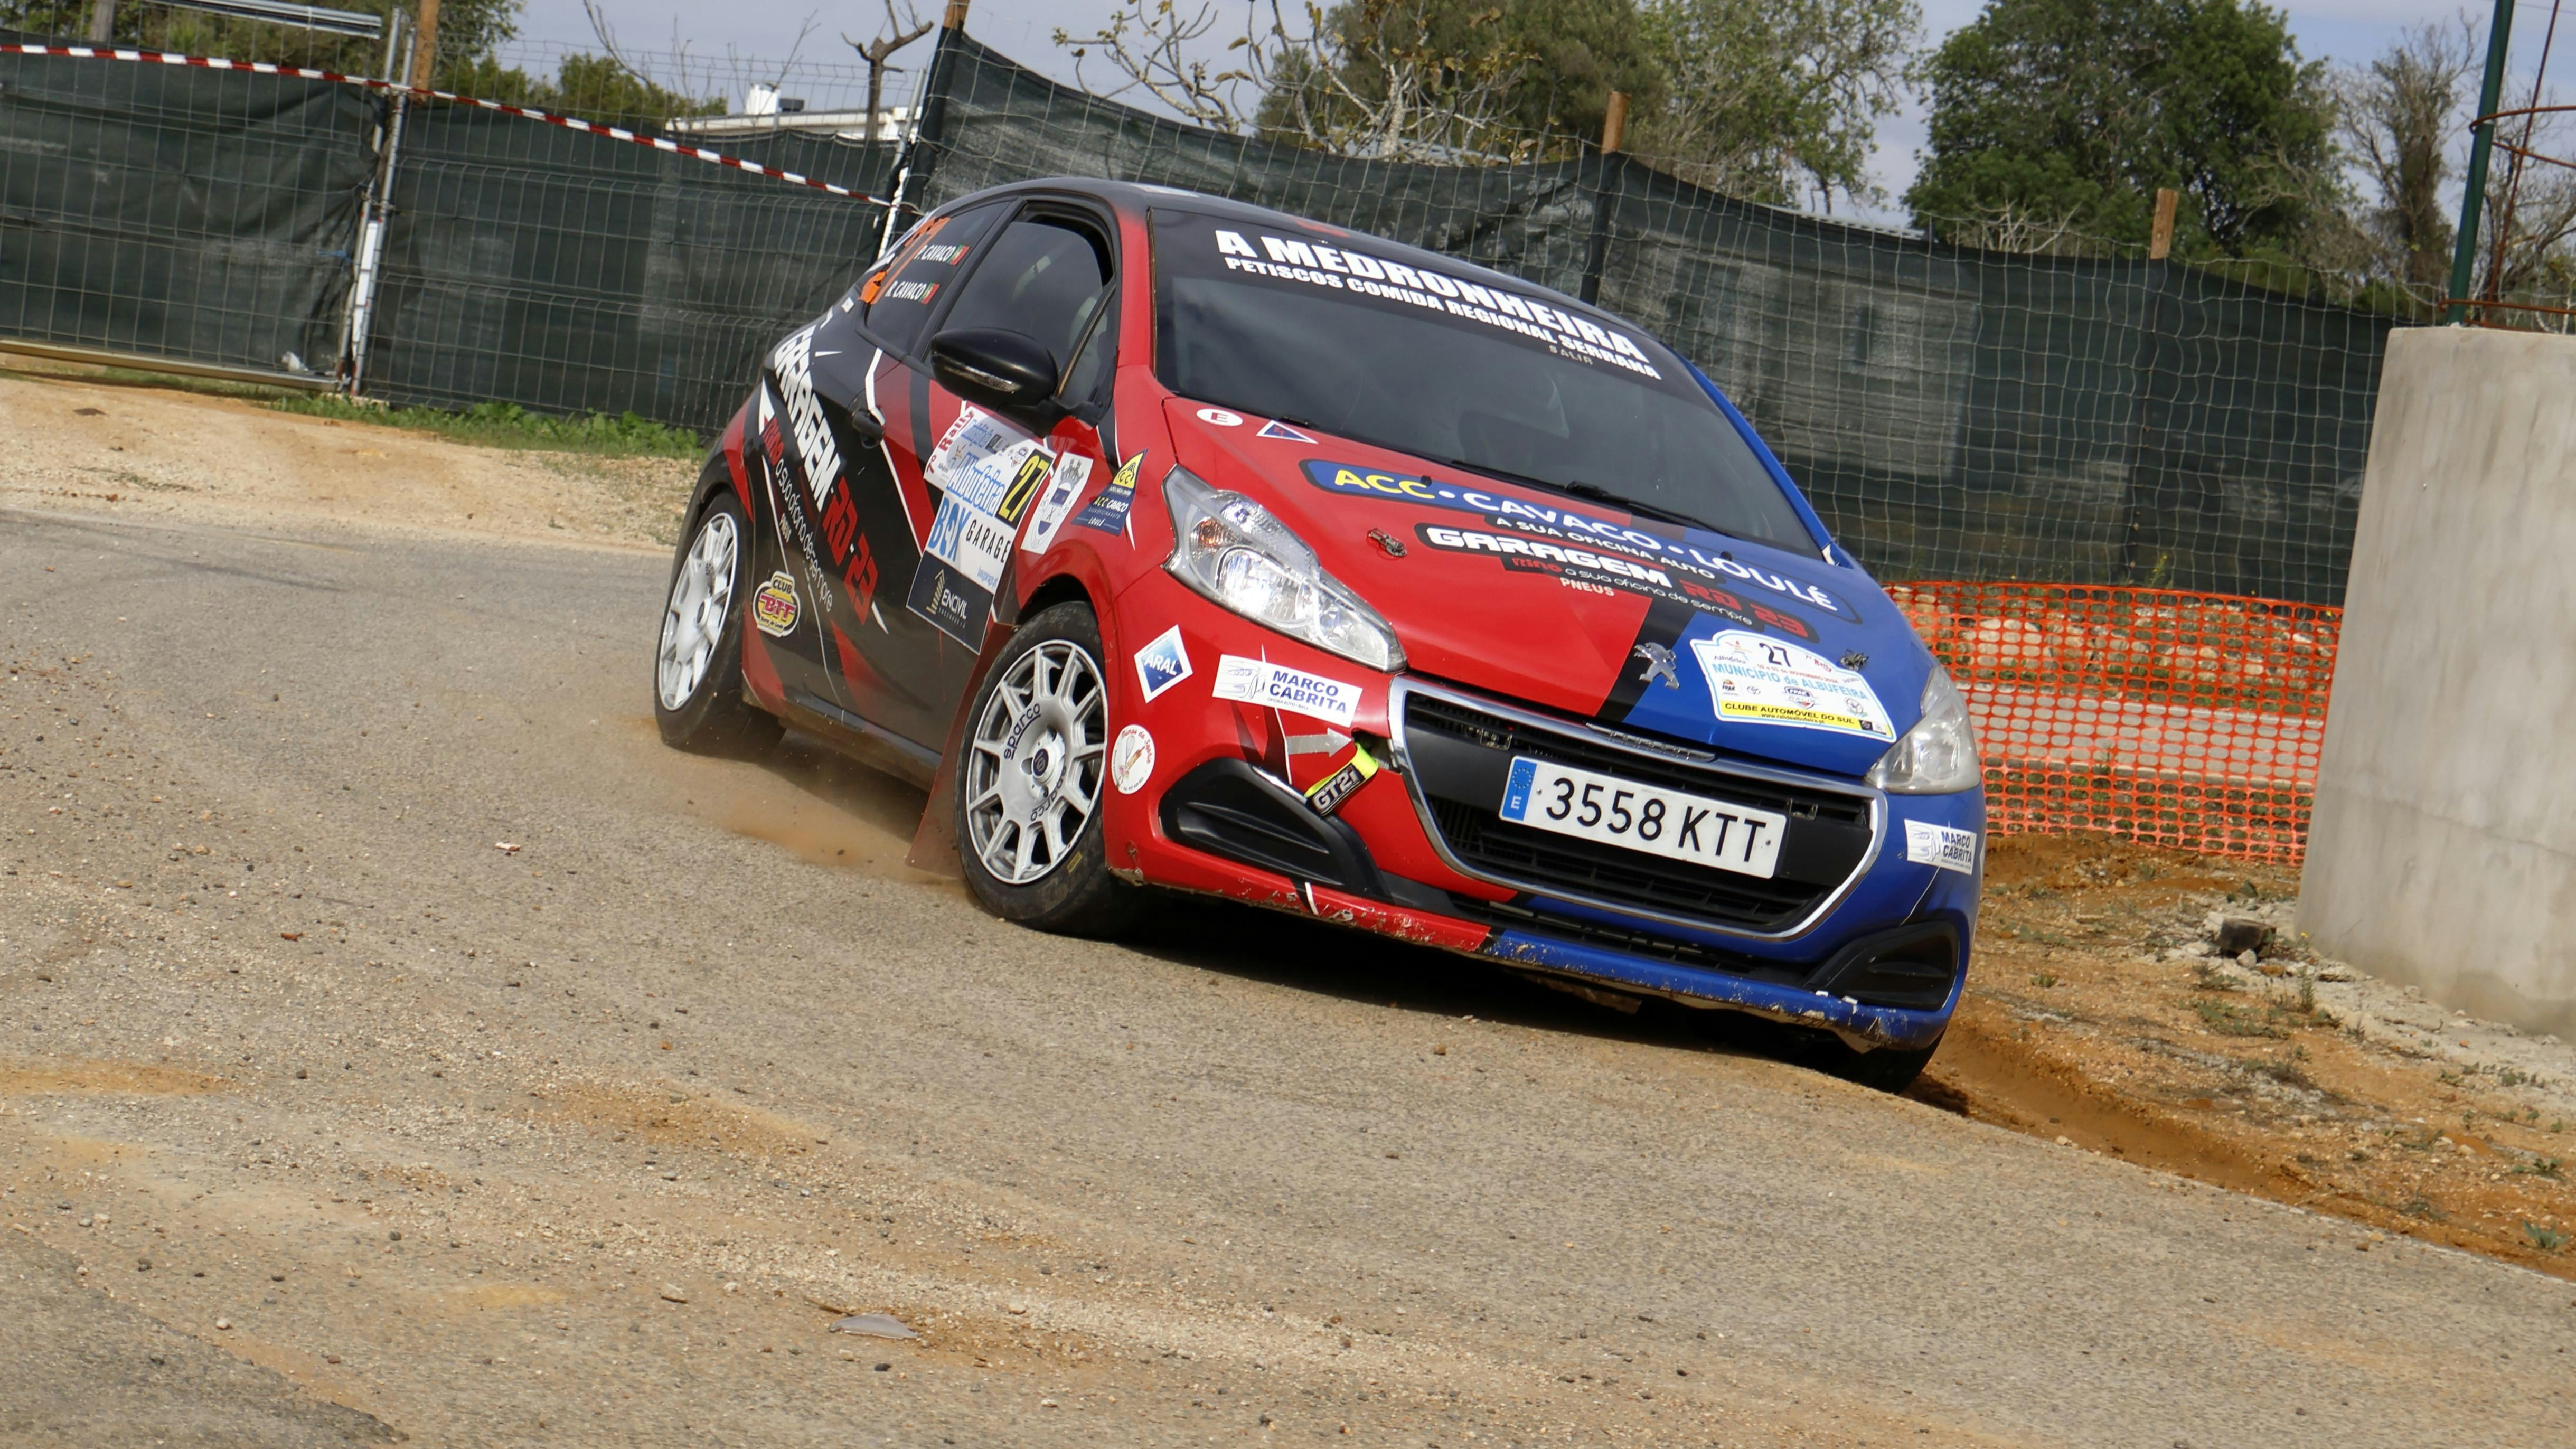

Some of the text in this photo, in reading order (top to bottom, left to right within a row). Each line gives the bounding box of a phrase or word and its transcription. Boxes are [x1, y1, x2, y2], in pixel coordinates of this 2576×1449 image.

[921, 244, 956, 262] CAVACO
[1215, 230, 1258, 258] A
[892, 280, 927, 301] CAVACO
[1224, 257, 1663, 380] PETISCOS COMIDA REGIONAL SERRANA
[1548, 344, 1594, 365] SALIR
[938, 410, 975, 452] Rally
[1210, 412, 1229, 423] E
[774, 324, 841, 513] GARAGEM
[843, 532, 879, 626] 23
[777, 467, 793, 504] sua
[945, 451, 1006, 518] Albufeira
[998, 454, 1050, 523] 27
[1093, 496, 1109, 507] ACC
[927, 496, 1012, 564] BOX GARAGE
[1334, 468, 1838, 612] ACC CAVACO LOULÉ
[1496, 517, 1716, 580] A SUA OFICINA AUTO
[773, 579, 793, 594] CLUB
[1426, 526, 1809, 638] GARAGEM RD 23
[1559, 577, 1615, 597] PNEUS
[1564, 568, 1577, 577] a
[1578, 570, 1612, 584] sua
[1613, 578, 1666, 597] oficina
[1668, 591, 1688, 604] de
[1690, 600, 1752, 625] sempre
[759, 592, 796, 621] BTT
[941, 587, 968, 620] ENCIVIL
[1144, 651, 1178, 676] ARAL
[1758, 642, 1791, 668] 27
[1813, 658, 1832, 673] Rally
[1272, 670, 1339, 697] MARCO
[1712, 663, 1870, 701] MUNICÍPIO de ALBUFEIRA
[1269, 683, 1347, 714] CABRITA
[1725, 703, 1759, 712] CLUBE
[1760, 706, 1819, 719] AUTOMÓVEL
[1837, 716, 1855, 724] SUL
[1312, 764, 1360, 811] GT2i
[1510, 777, 1766, 863] E 3558 KTT
[1941, 831, 1971, 848] MARCO
[1942, 845, 1972, 864] CABRITA
